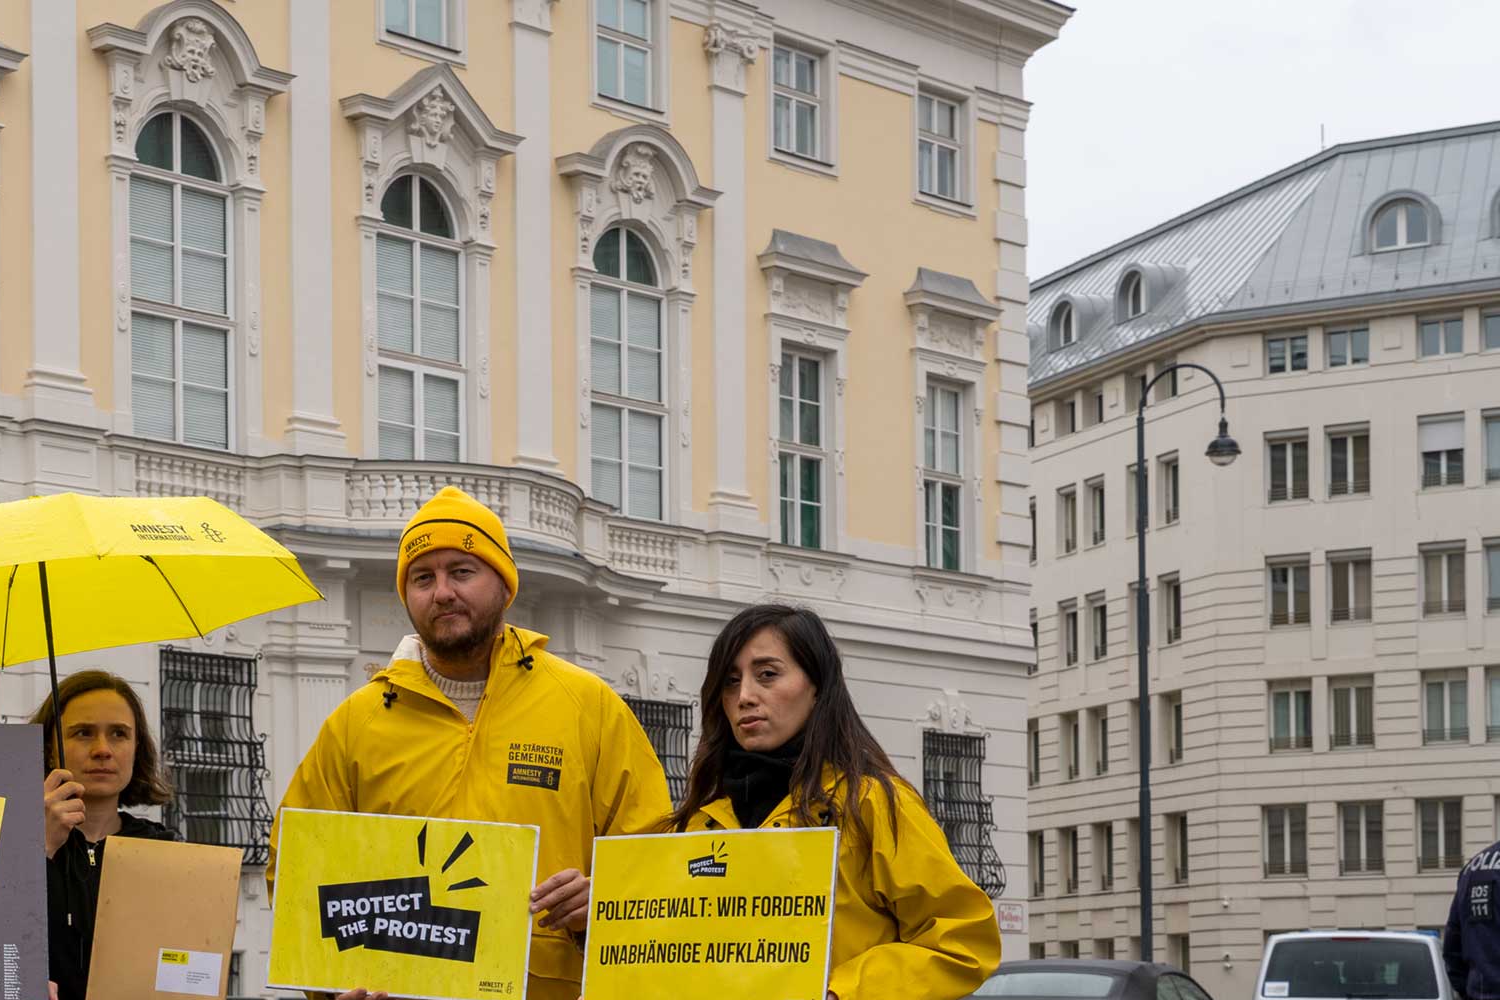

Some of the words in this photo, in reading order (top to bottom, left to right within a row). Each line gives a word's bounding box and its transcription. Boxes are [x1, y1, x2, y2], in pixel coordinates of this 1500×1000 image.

[130, 524, 187, 534] AMNESTY
[508, 752, 563, 767] GEMEINSAM
[512, 768, 541, 777] AMNESTY
[327, 893, 423, 918] PROTECT
[596, 896, 712, 921] POLIZEIGEWALT:
[717, 896, 747, 918] WIR
[752, 895, 826, 917] FORDERN
[338, 919, 368, 938] THE
[374, 918, 471, 946] PROTEST
[600, 939, 701, 965] UNABHÄNGIGE
[705, 939, 811, 963] AUFKLÄRUNG
[479, 980, 503, 988] AMNESTY
